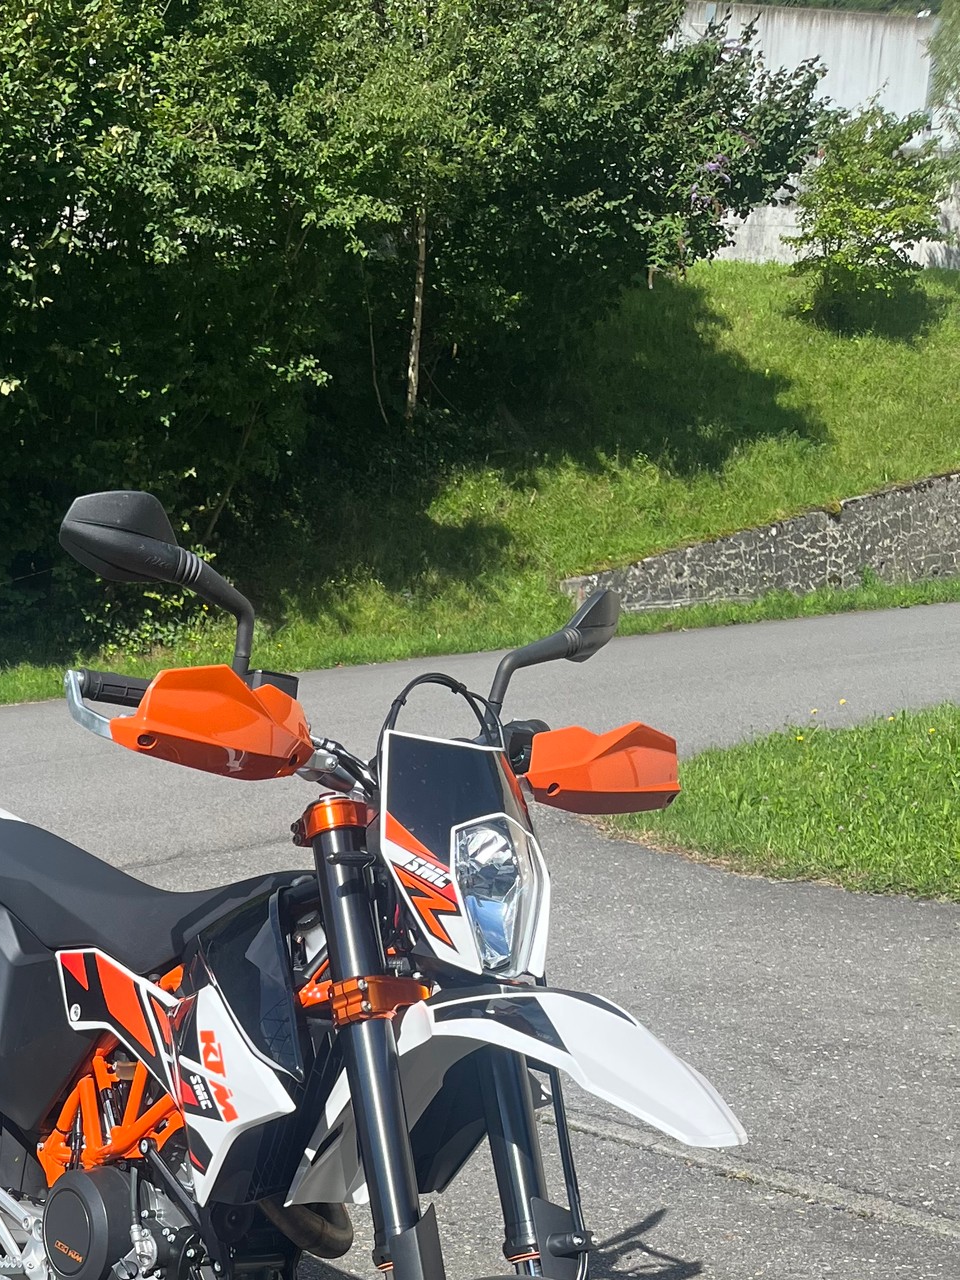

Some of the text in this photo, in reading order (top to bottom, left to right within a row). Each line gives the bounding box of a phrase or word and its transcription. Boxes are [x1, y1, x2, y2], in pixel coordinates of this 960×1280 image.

[404, 857, 452, 889] SMC
[189, 1074, 213, 1110] SMC
[199, 1030, 239, 1123] KTM
